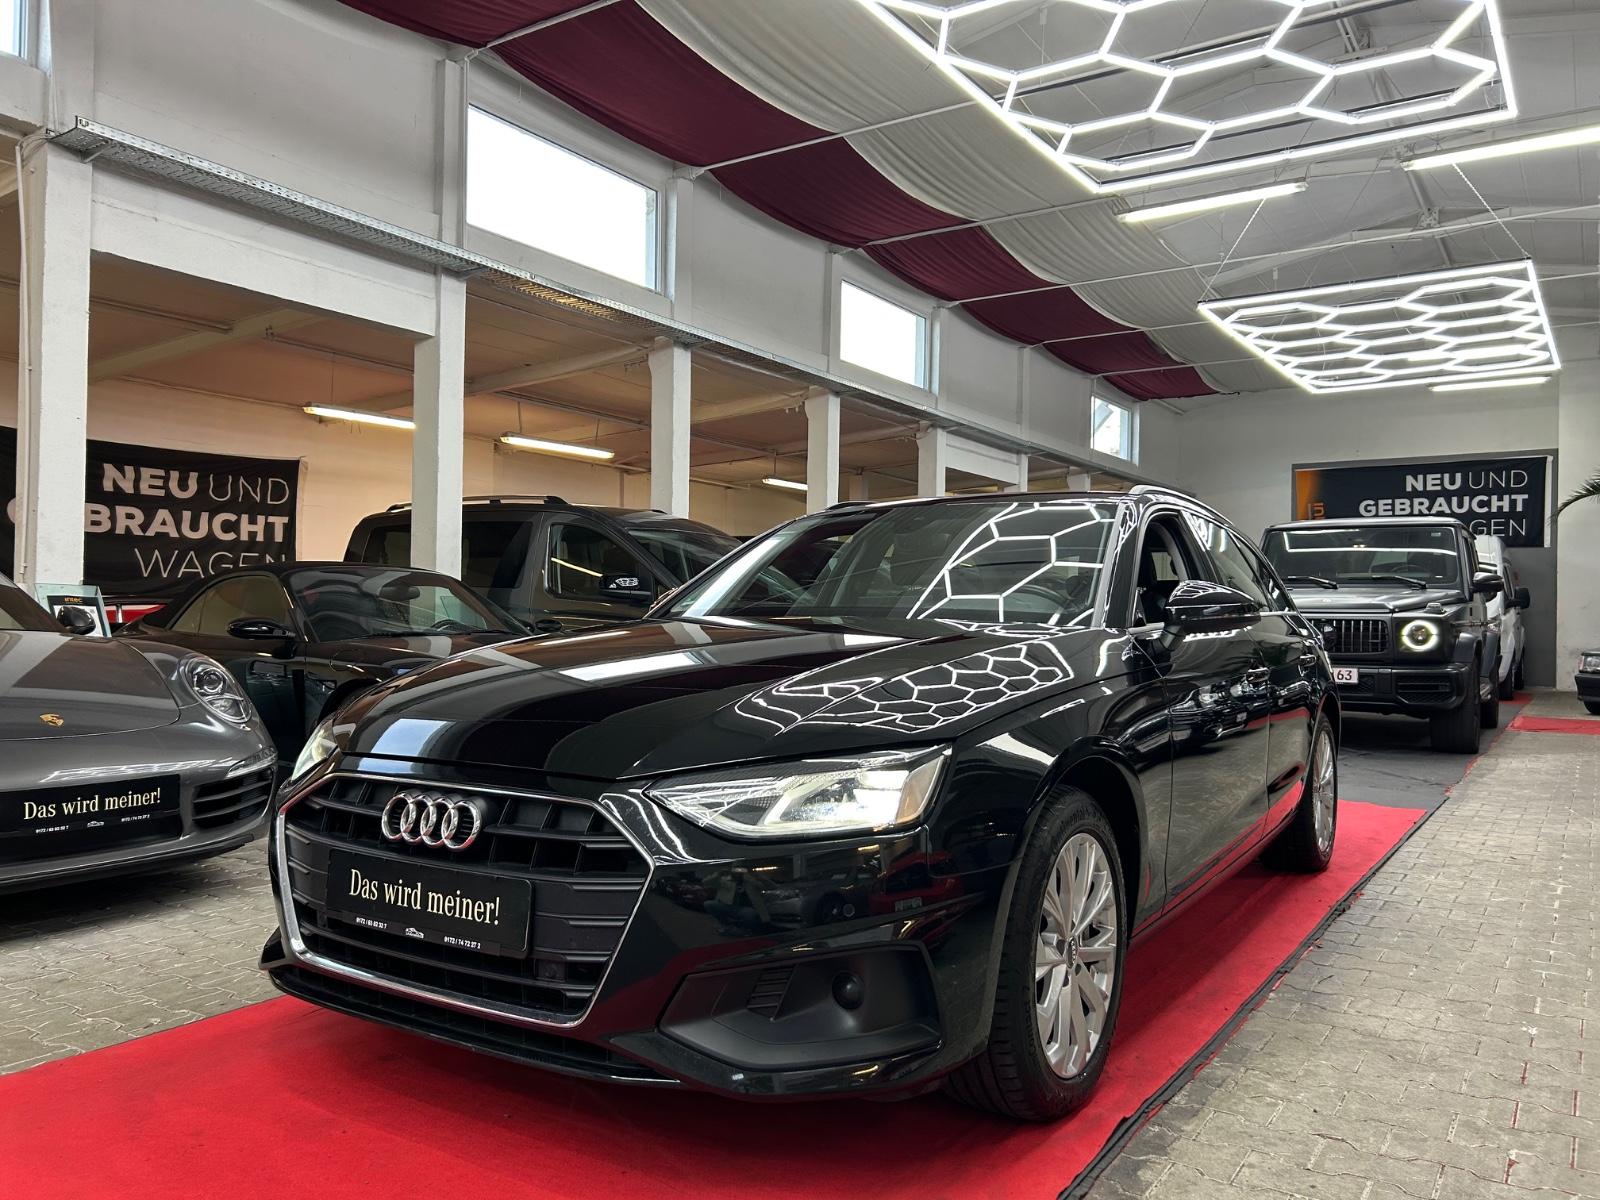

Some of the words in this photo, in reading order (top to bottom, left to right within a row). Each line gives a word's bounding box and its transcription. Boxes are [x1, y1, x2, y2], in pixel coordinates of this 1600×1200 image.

[103, 463, 199, 499] NEU
[209, 474, 290, 505] UND
[1405, 472, 1462, 492] NEU
[1468, 470, 1528, 489] UND
[1358, 494, 1529, 517] GEBRAUCHT
[7, 497, 289, 543] BRAUCHT
[1469, 518, 1527, 537] GEN
[1337, 669, 1352, 681] 63
[23, 801, 56, 820] Das
[62, 795, 99, 816] wird
[104, 787, 161, 811] meiner!
[349, 868, 378, 901] Das
[383, 879, 421, 910] wird
[426, 889, 500, 926] meiner!
